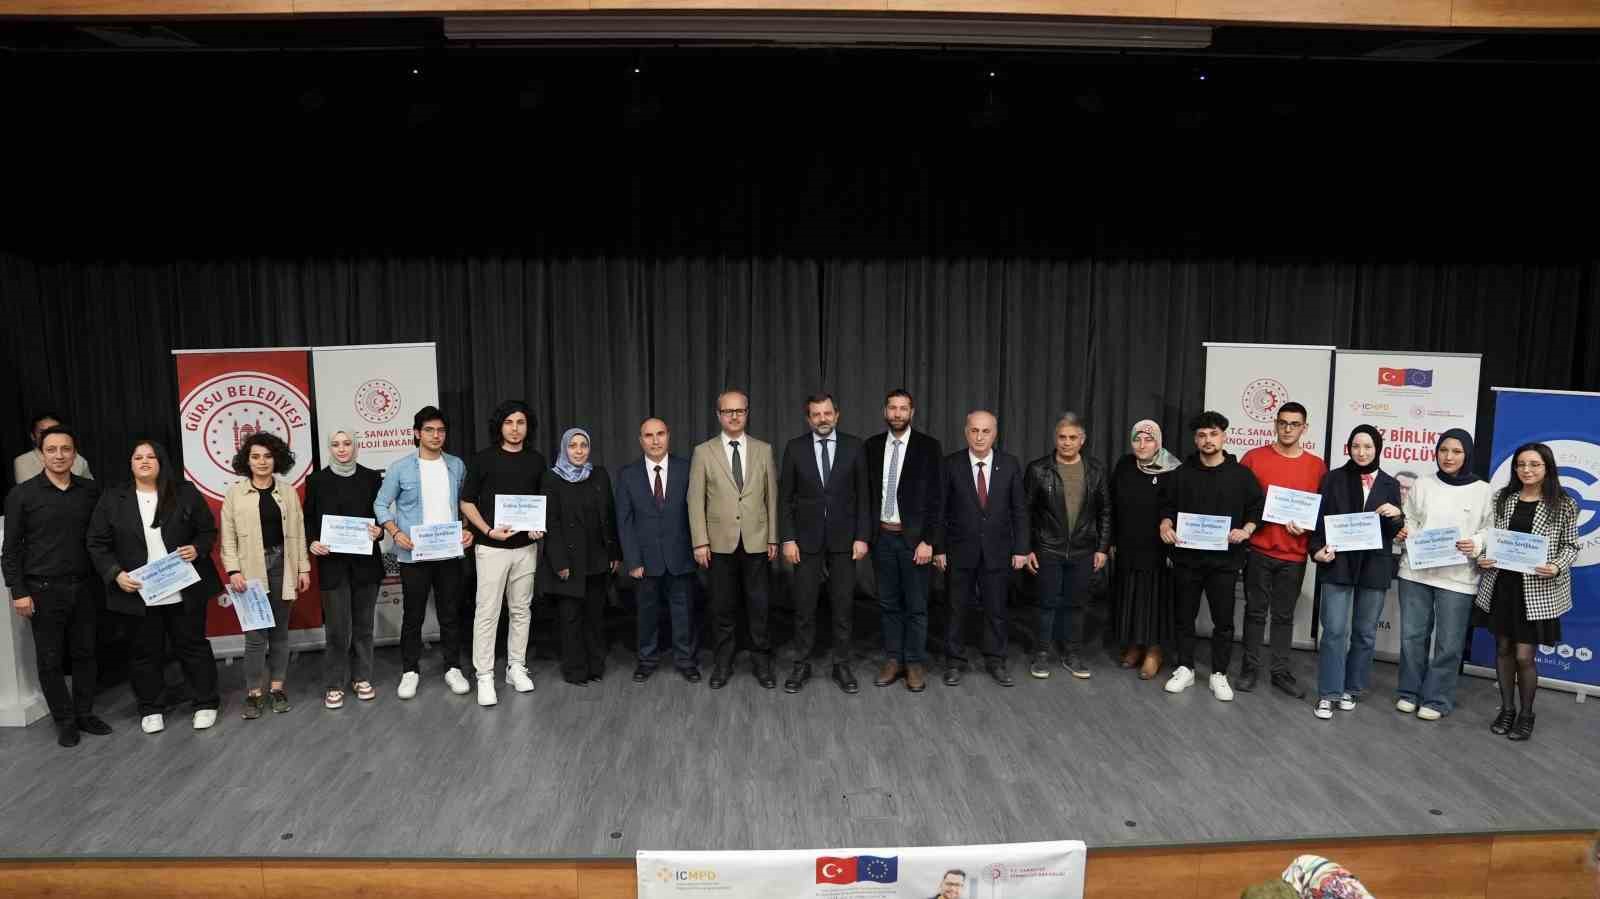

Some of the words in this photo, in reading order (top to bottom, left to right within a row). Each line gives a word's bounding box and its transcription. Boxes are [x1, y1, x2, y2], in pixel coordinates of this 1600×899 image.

[186, 391, 223, 432] GÜRSU
[227, 385, 307, 428] BELEDİYESİ
[400, 427, 413, 436] VE
[1247, 428, 1277, 437] SANA
[1390, 426, 1442, 445] BİRLİK
[382, 438, 416, 448] BAKAN
[1383, 444, 1438, 464] GÜÇLÜY
[675, 871, 717, 881] ICMPD
